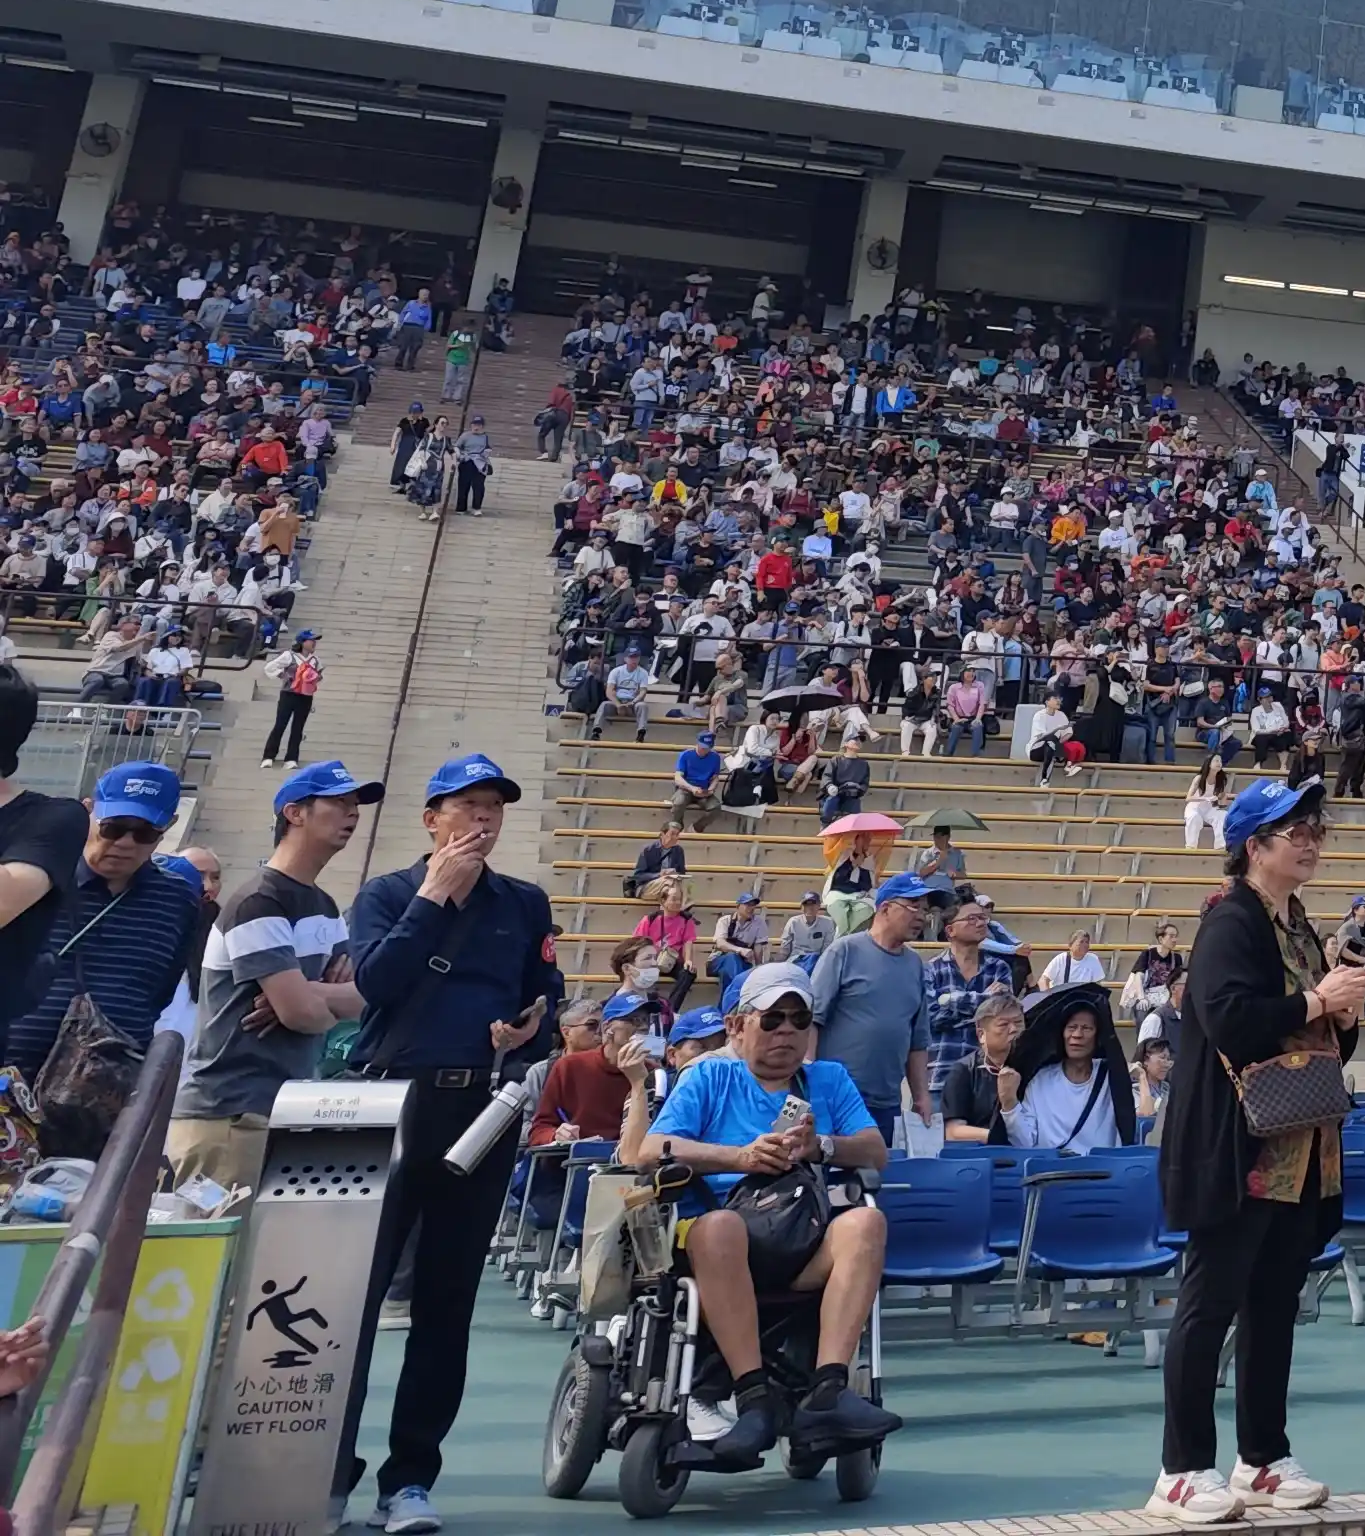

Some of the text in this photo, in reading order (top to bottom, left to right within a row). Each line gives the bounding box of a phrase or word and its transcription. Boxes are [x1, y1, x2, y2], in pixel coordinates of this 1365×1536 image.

[234, 1372, 335, 1397] 小心地滑
[237, 1400, 313, 1415] CAUTION
[226, 1418, 327, 1436] WET FLOOR
